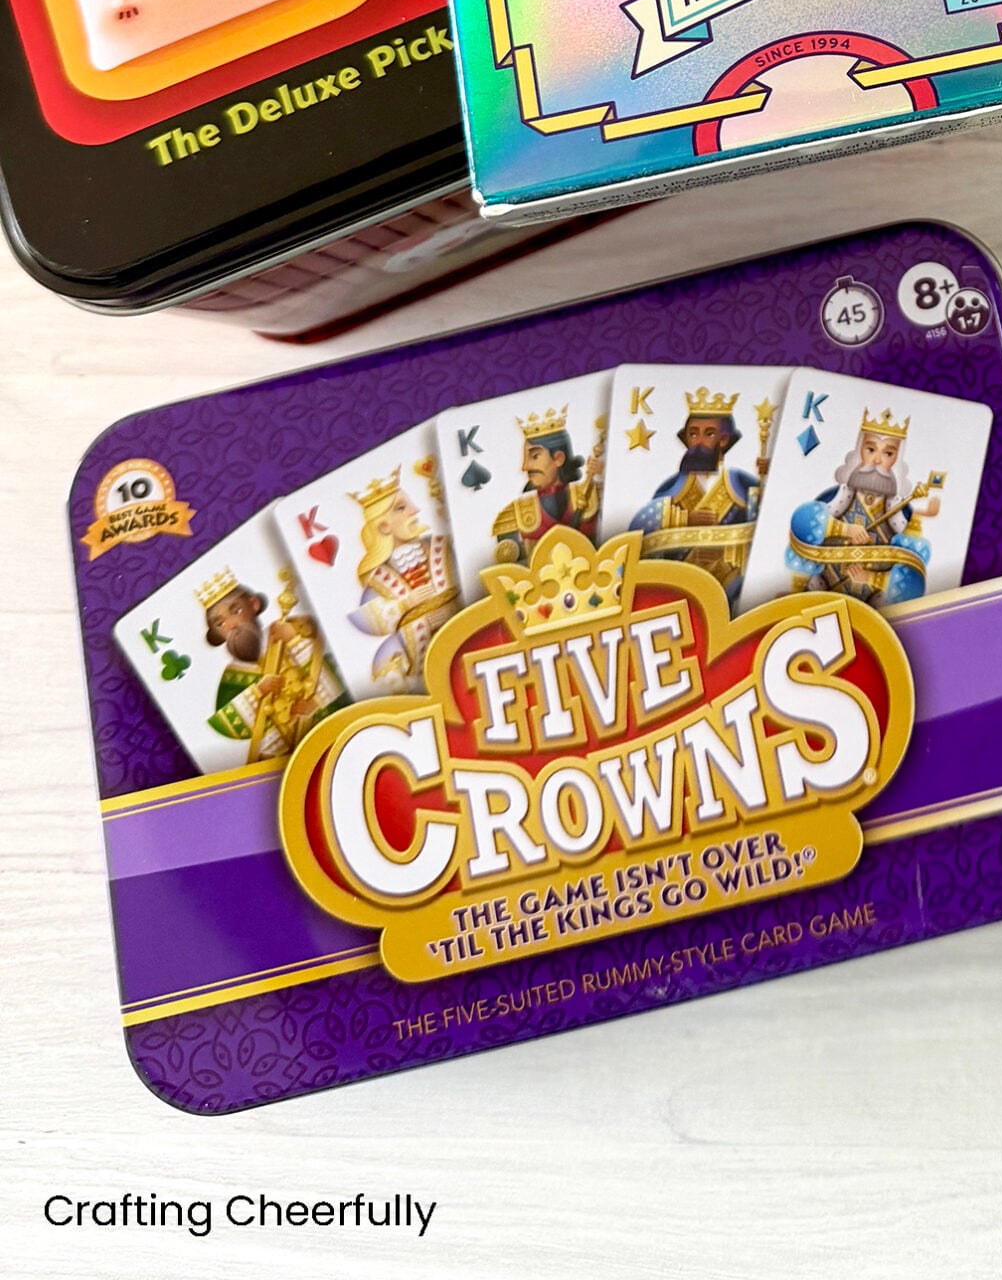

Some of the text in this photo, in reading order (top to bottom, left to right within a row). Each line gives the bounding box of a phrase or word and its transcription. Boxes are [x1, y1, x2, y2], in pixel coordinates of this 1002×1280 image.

[755, 36, 851, 67] SINCE 1994
[147, 26, 454, 167] The Deluxe Pick
[913, 277, 954, 310] 8+
[837, 303, 866, 325] 45
[957, 312, 982, 330] 1-7
[925, 328, 947, 339] 4156
[629, 386, 656, 415] K
[801, 391, 830, 422] K
[456, 425, 484, 457] K
[117, 478, 153, 503] 10
[100, 511, 180, 542] AWARDS
[108, 503, 168, 523] BEST GAME
[296, 505, 328, 540] K
[140, 625, 173, 654] K
[473, 611, 694, 746] FIVE
[453, 832, 787, 933] THE GAME ISN'T OVER
[427, 932, 486, 965] 'TIL
[491, 920, 549, 950] THE
[555, 893, 654, 937] KINGS
[660, 876, 708, 909] GO
[393, 901, 878, 1041] THE FIVE-SUITED RUMMY-STYLE CARD GAME
